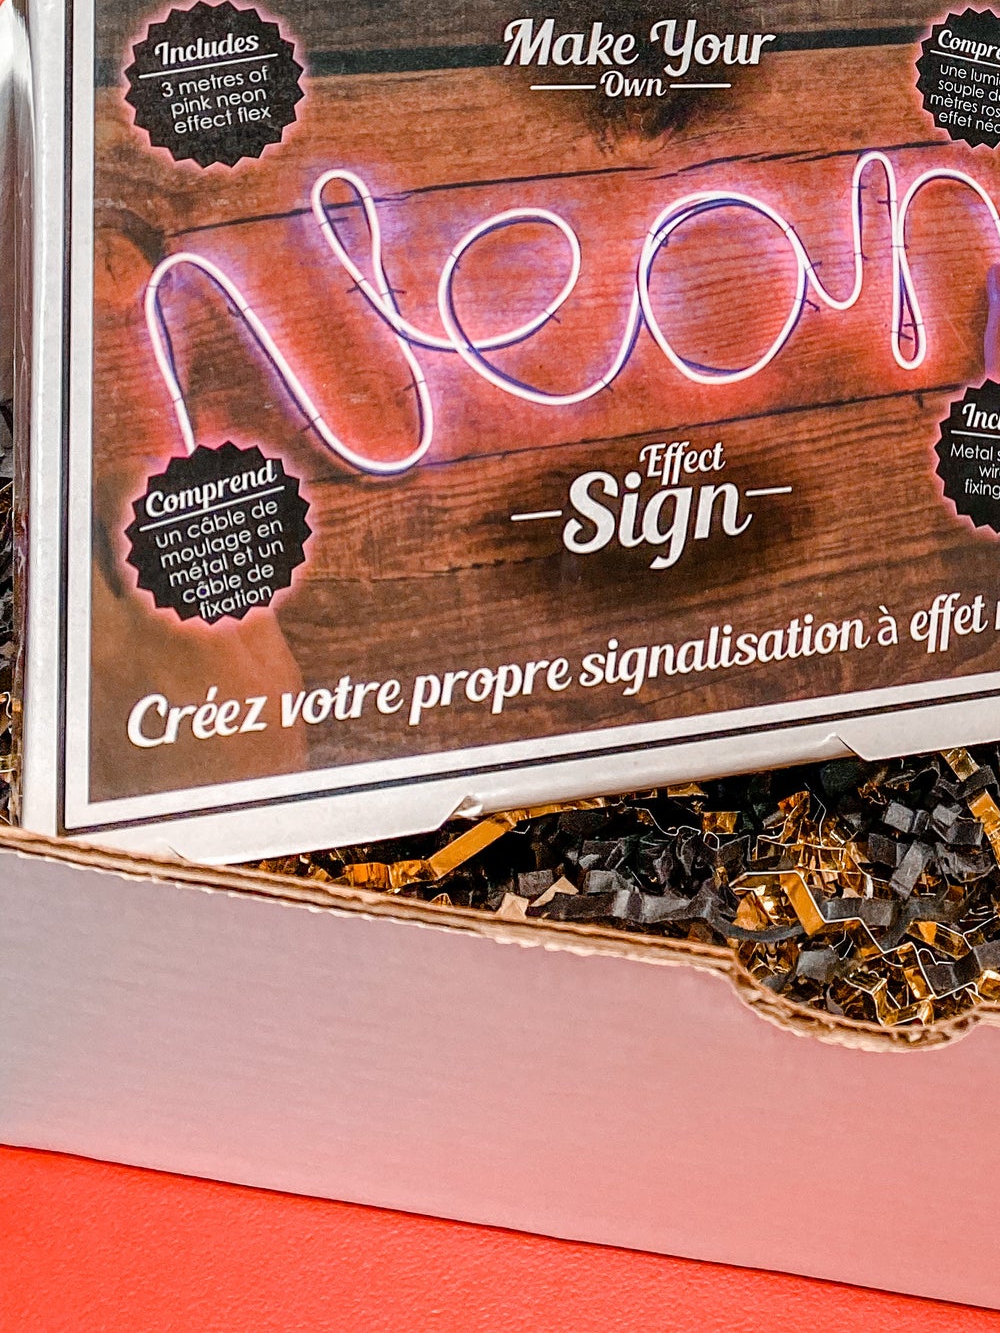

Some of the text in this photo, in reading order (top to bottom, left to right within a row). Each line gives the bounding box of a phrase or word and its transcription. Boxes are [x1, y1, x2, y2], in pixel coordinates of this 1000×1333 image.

[154, 32, 260, 66] Includes
[503, 18, 777, 74] Make Your
[161, 65, 269, 98] 3 metres of
[599, 70, 668, 98] Own
[938, 79, 985, 99] souple
[940, 64, 967, 79] une
[170, 88, 267, 119] pink neon
[174, 106, 272, 134] effect flex
[930, 93, 978, 113] mètres
[938, 111, 973, 128] effet
[639, 441, 726, 487] Effect
[950, 442, 993, 462] Metal
[145, 459, 278, 517] Comprend
[155, 499, 279, 549] un câble de
[562, 470, 753, 570] Sign
[160, 519, 284, 569] moulage en
[168, 540, 285, 588] métal et un
[182, 562, 275, 604] câble de
[199, 583, 273, 619] fixation
[126, 685, 269, 749] Créez
[280, 674, 405, 729] votre
[408, 655, 573, 726] propre
[577, 613, 871, 697] signalisation
[876, 604, 899, 647] à
[909, 592, 990, 654] effet
